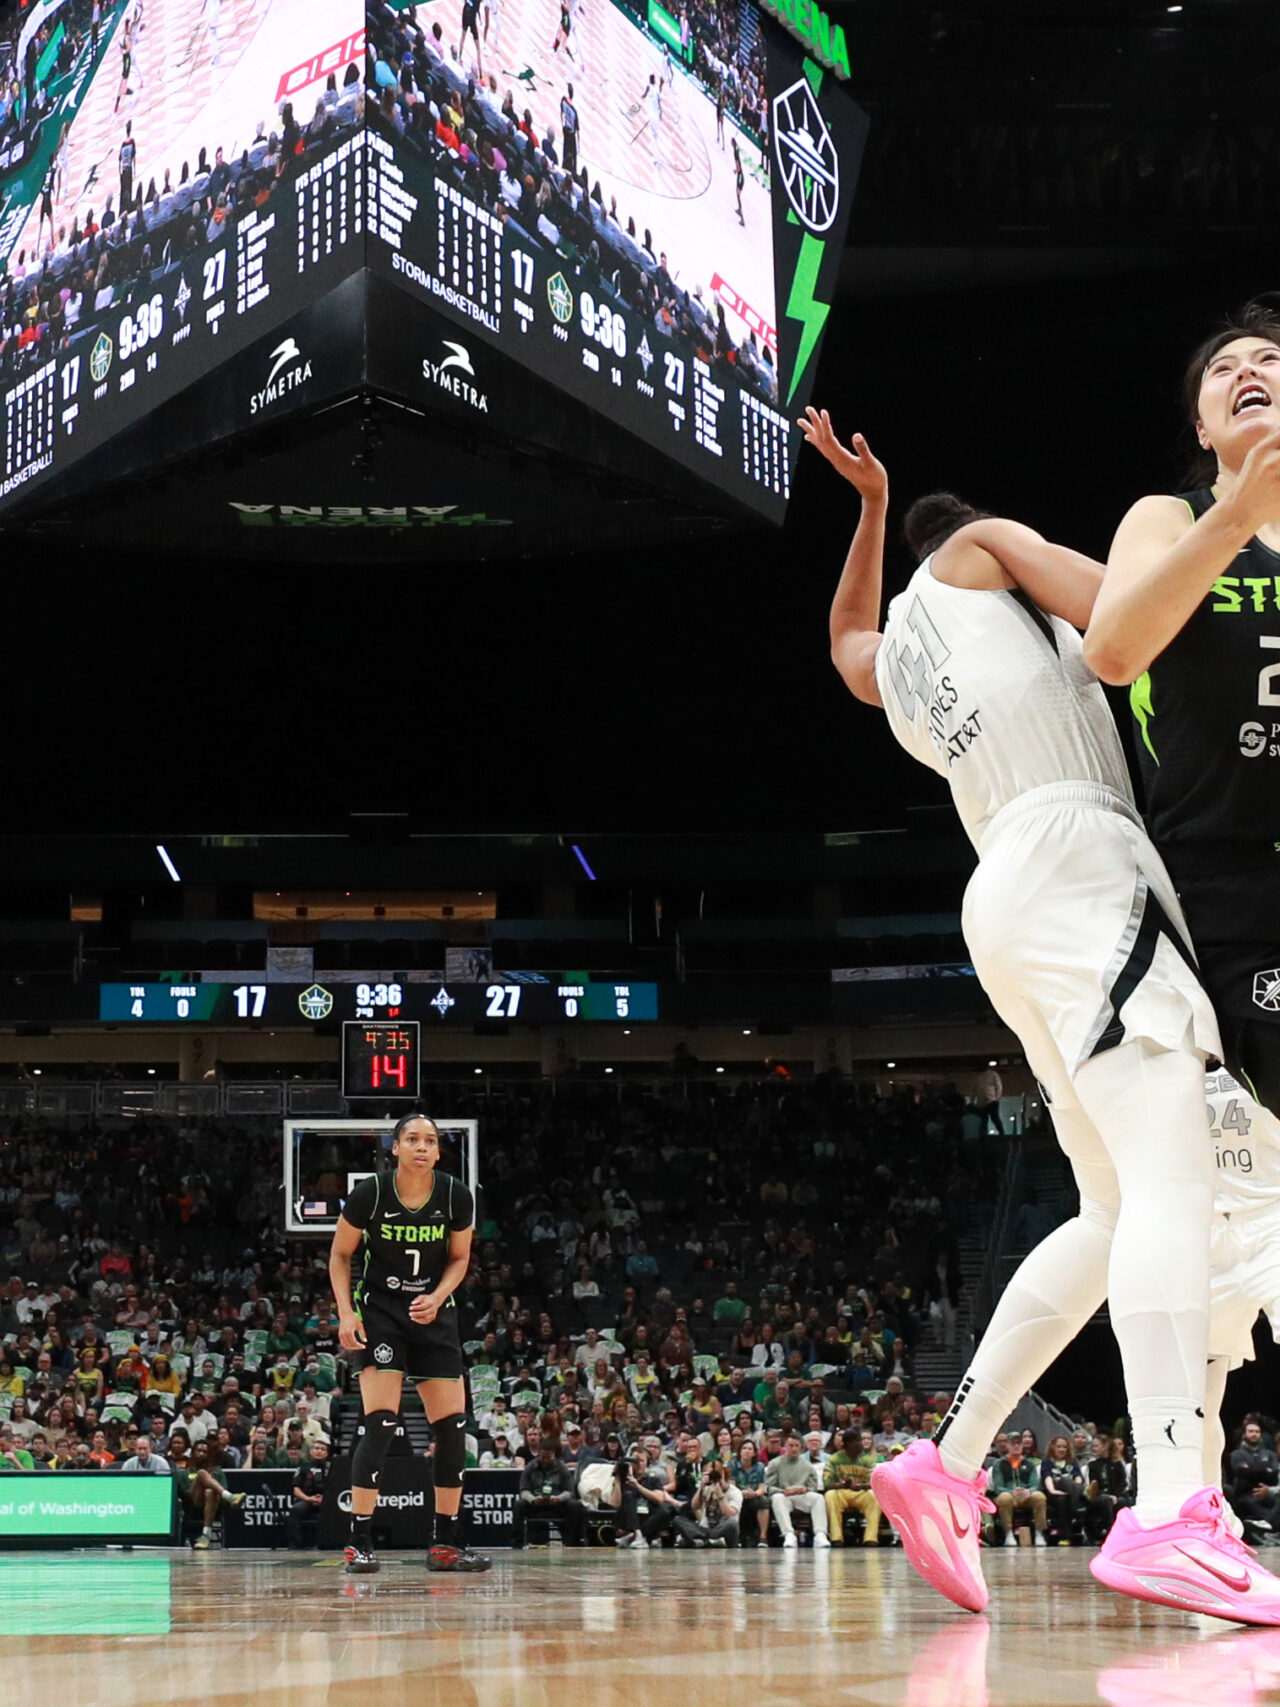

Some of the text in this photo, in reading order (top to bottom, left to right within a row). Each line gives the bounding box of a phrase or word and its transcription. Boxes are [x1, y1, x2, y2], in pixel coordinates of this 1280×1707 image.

[341, 195, 346, 210] 2
[327, 222, 331, 235] 1
[340, 212, 346, 226] 2
[439, 214, 444, 228] 2
[454, 225, 458, 237] 1
[468, 233, 472, 247] 2
[299, 258, 304, 272] 2
[326, 239, 331, 253] 2
[439, 246, 444, 260] 2
[482, 275, 486, 288] 1
[454, 240, 458, 253] 1
[482, 259, 486, 271] 1
[203, 248, 226, 300] 27
[511, 249, 533, 295] 17
[392, 252, 500, 333] STORM BASKETBALL!
[206, 300, 225, 324] FOULS
[514, 298, 534, 322] FOULS
[119, 294, 163, 360] 9:36
[580, 292, 626, 358] 9:36
[147, 352, 156, 372] 14
[664, 352, 684, 396] 27
[61, 356, 80, 400] 17
[250, 361, 312, 414] SYMETRA
[422, 360, 488, 413] SYMETRA
[611, 367, 621, 386] 14
[4, 451, 52, 494] BASKETBALL!
[887, 593, 951, 722] 41
[947, 710, 984, 767] AT&T
[130, 986, 630, 997] TOL FOULS FOULS TOL
[234, 986, 266, 1017] 17
[356, 984, 402, 1006] 9:36
[430, 998, 455, 1006] ACES
[486, 986, 520, 1017] 27
[131, 999, 189, 1017] 4 0
[565, 999, 628, 1017] 0 5
[371, 1054, 407, 1088] 14
[1205, 1074, 1242, 1095] CE
[1216, 1146, 1253, 1173] ing
[381, 1224, 445, 1242] STORM
[405, 1249, 420, 1276] 7
[0, 1502, 134, 1517] al of Washington
[376, 1491, 424, 1510] trepid
[464, 1494, 519, 1508] SEATT
[244, 1511, 290, 1525] STO
[473, 1511, 513, 1524] STOR
